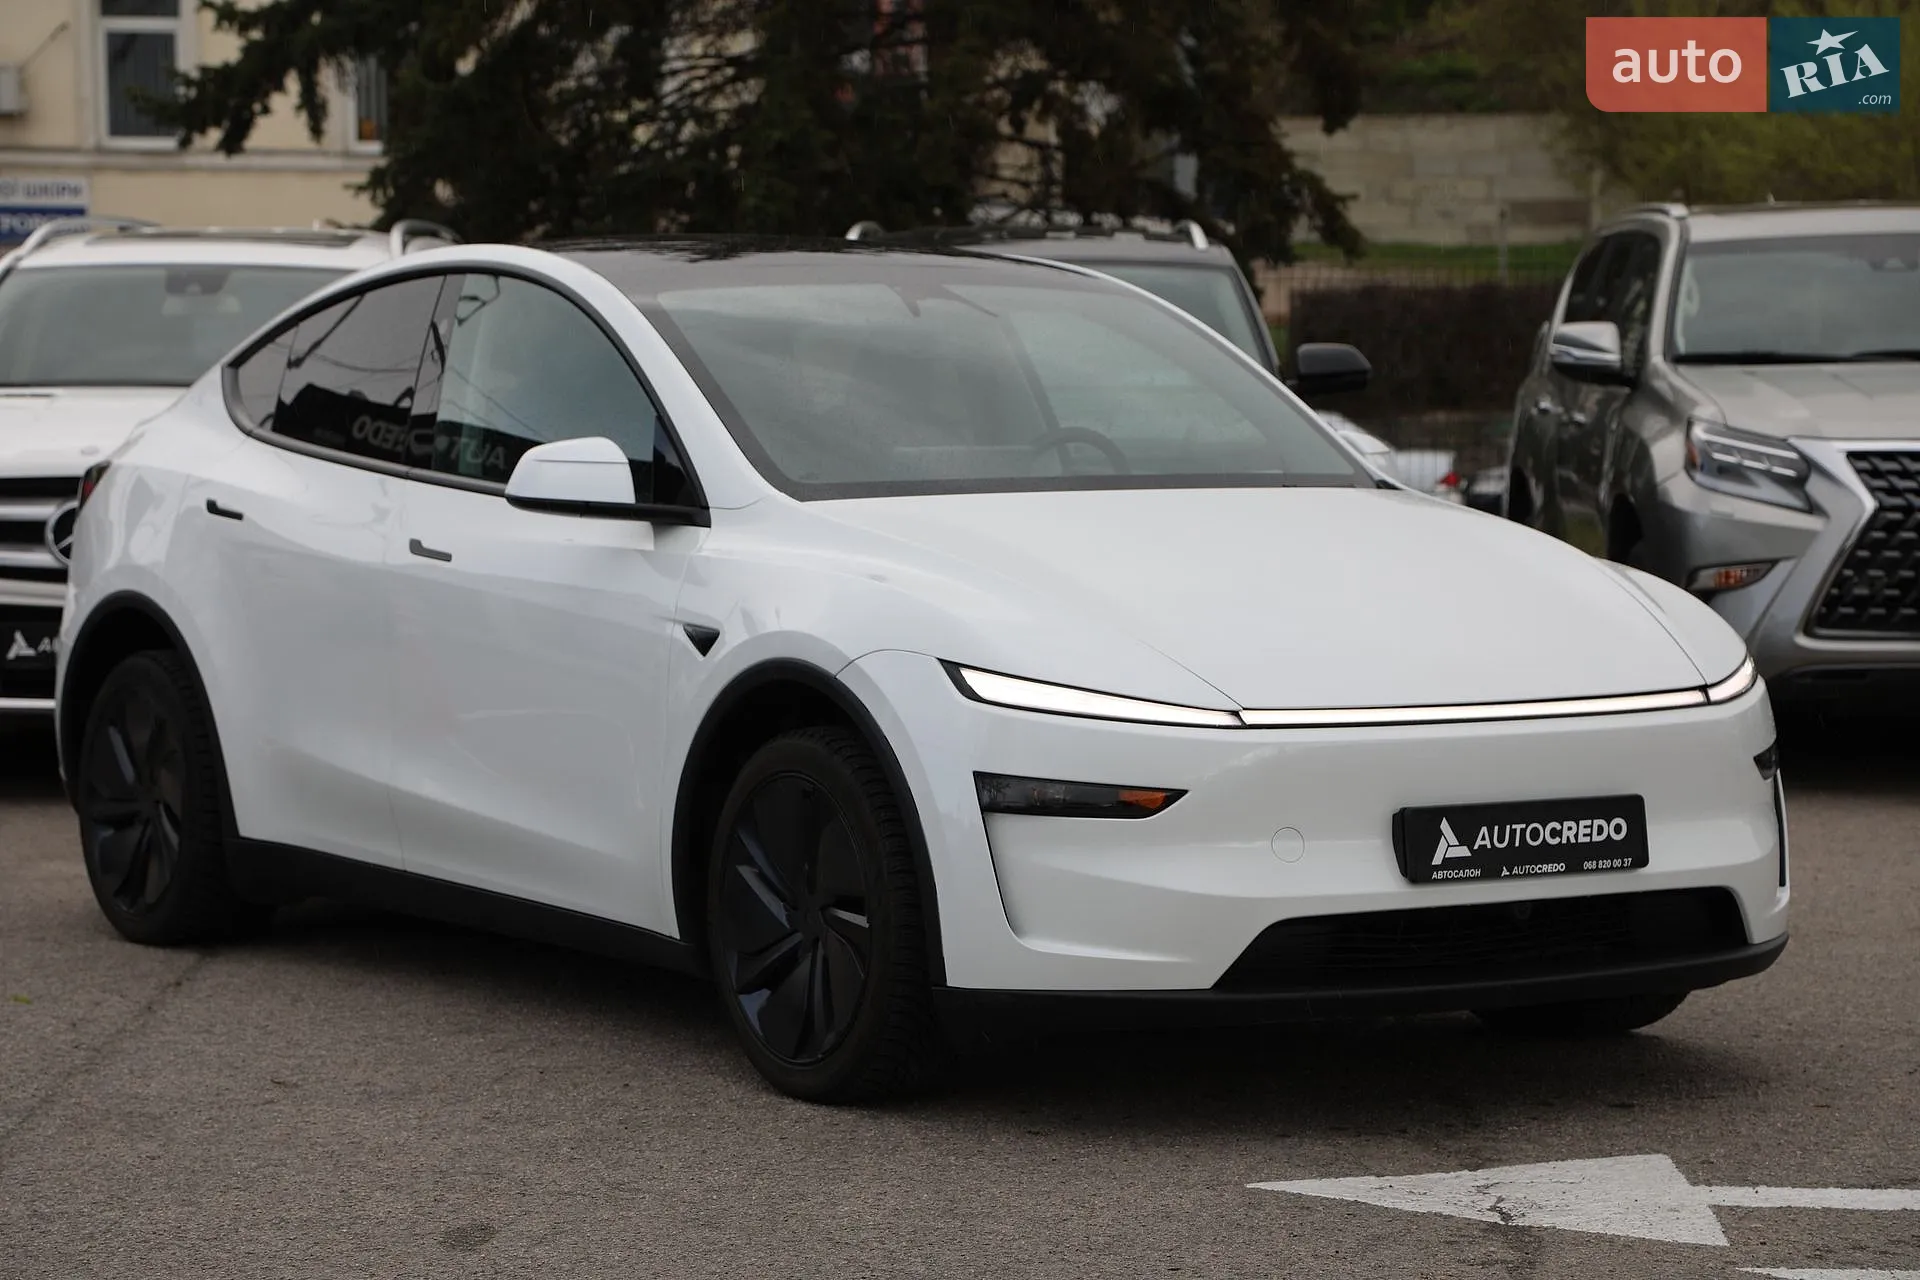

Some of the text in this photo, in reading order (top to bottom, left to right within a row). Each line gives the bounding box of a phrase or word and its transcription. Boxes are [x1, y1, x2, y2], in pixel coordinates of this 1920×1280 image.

[1473, 817, 1628, 850] AUTOCREDO
[1512, 863, 1566, 875] AUTOCREDO
[1583, 857, 1632, 870] 068 820 00 37
[1431, 868, 1481, 880] АВТОСАЛОН
